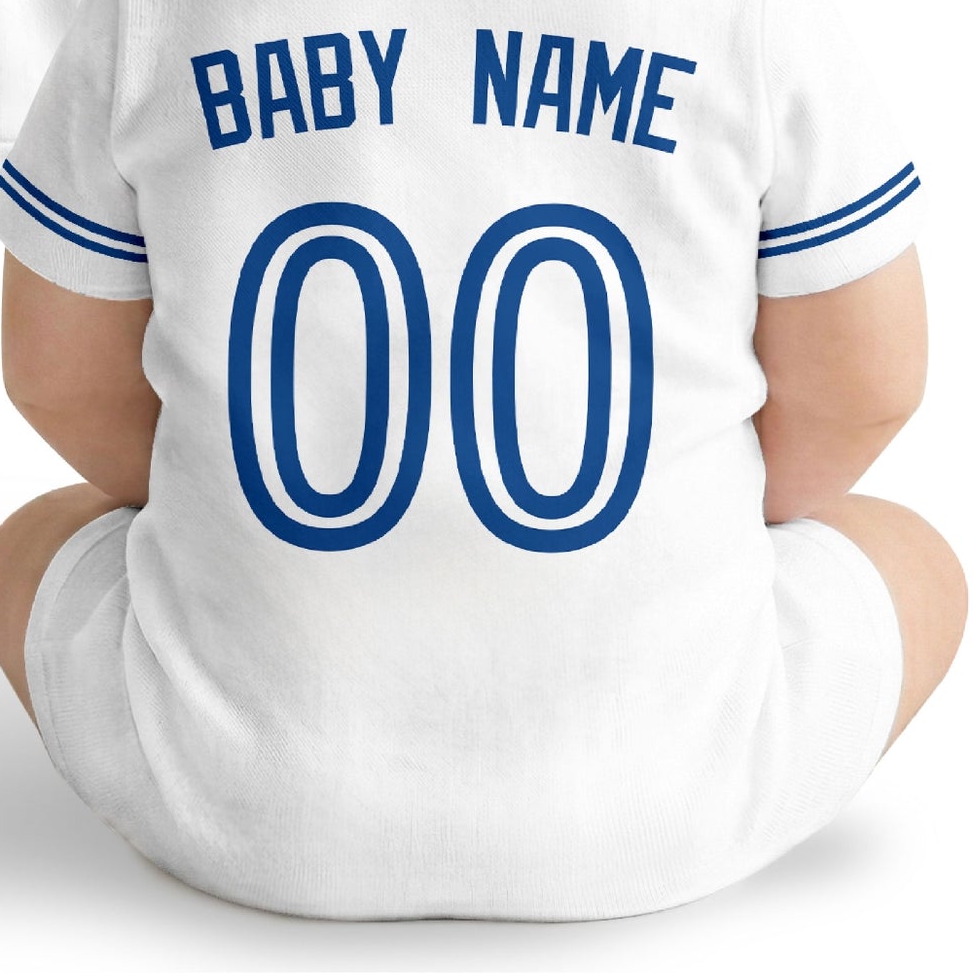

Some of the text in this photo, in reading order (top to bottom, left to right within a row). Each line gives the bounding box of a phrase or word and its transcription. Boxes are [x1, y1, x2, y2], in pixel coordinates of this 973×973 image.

[191, 28, 697, 154] BABY NAME
[228, 201, 654, 553] 00
